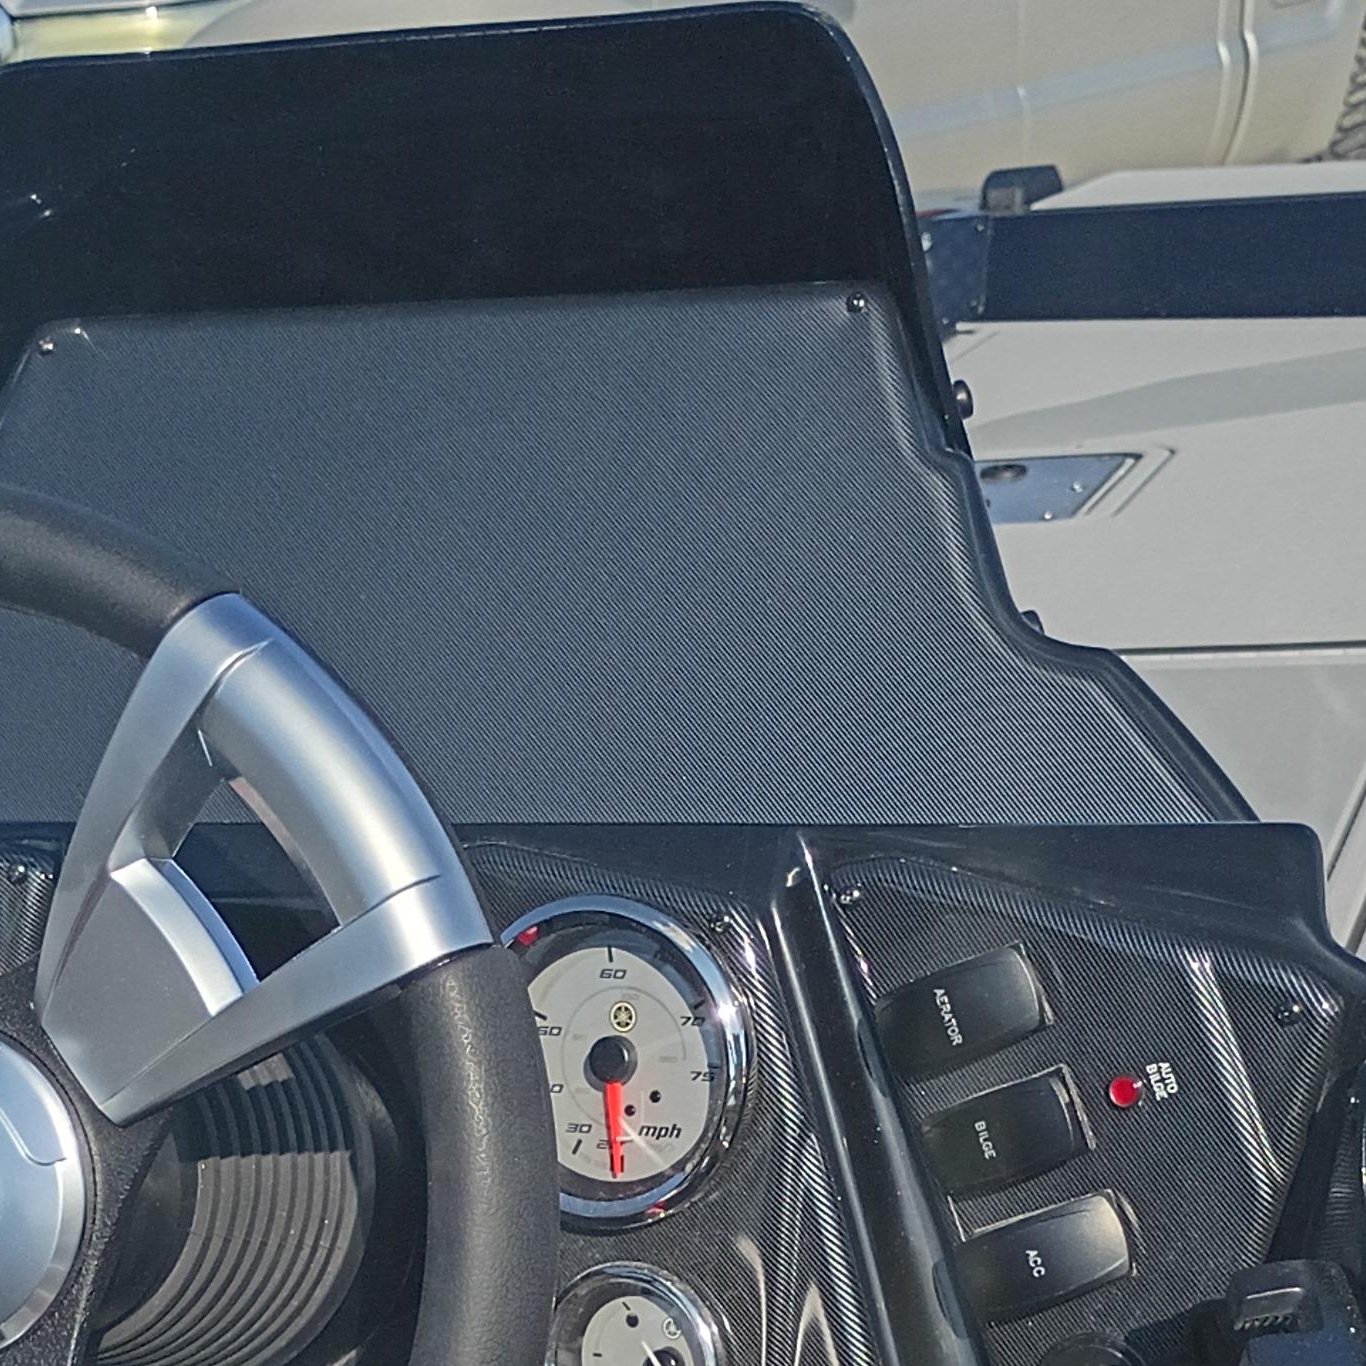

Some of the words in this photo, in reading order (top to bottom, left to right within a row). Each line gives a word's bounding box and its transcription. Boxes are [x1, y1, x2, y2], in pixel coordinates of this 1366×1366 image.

[599, 968, 626, 979] 60
[679, 1016, 707, 1027] 70
[932, 987, 963, 1046] AERATOR
[690, 1071, 716, 1082] 75
[1145, 1063, 1169, 1101] BILGE
[1157, 1061, 1178, 1094] AUTO
[564, 1122, 593, 1134] 30
[638, 1123, 683, 1141] mph
[974, 1120, 998, 1161] BILGE
[1025, 1250, 1045, 1277] ACC
